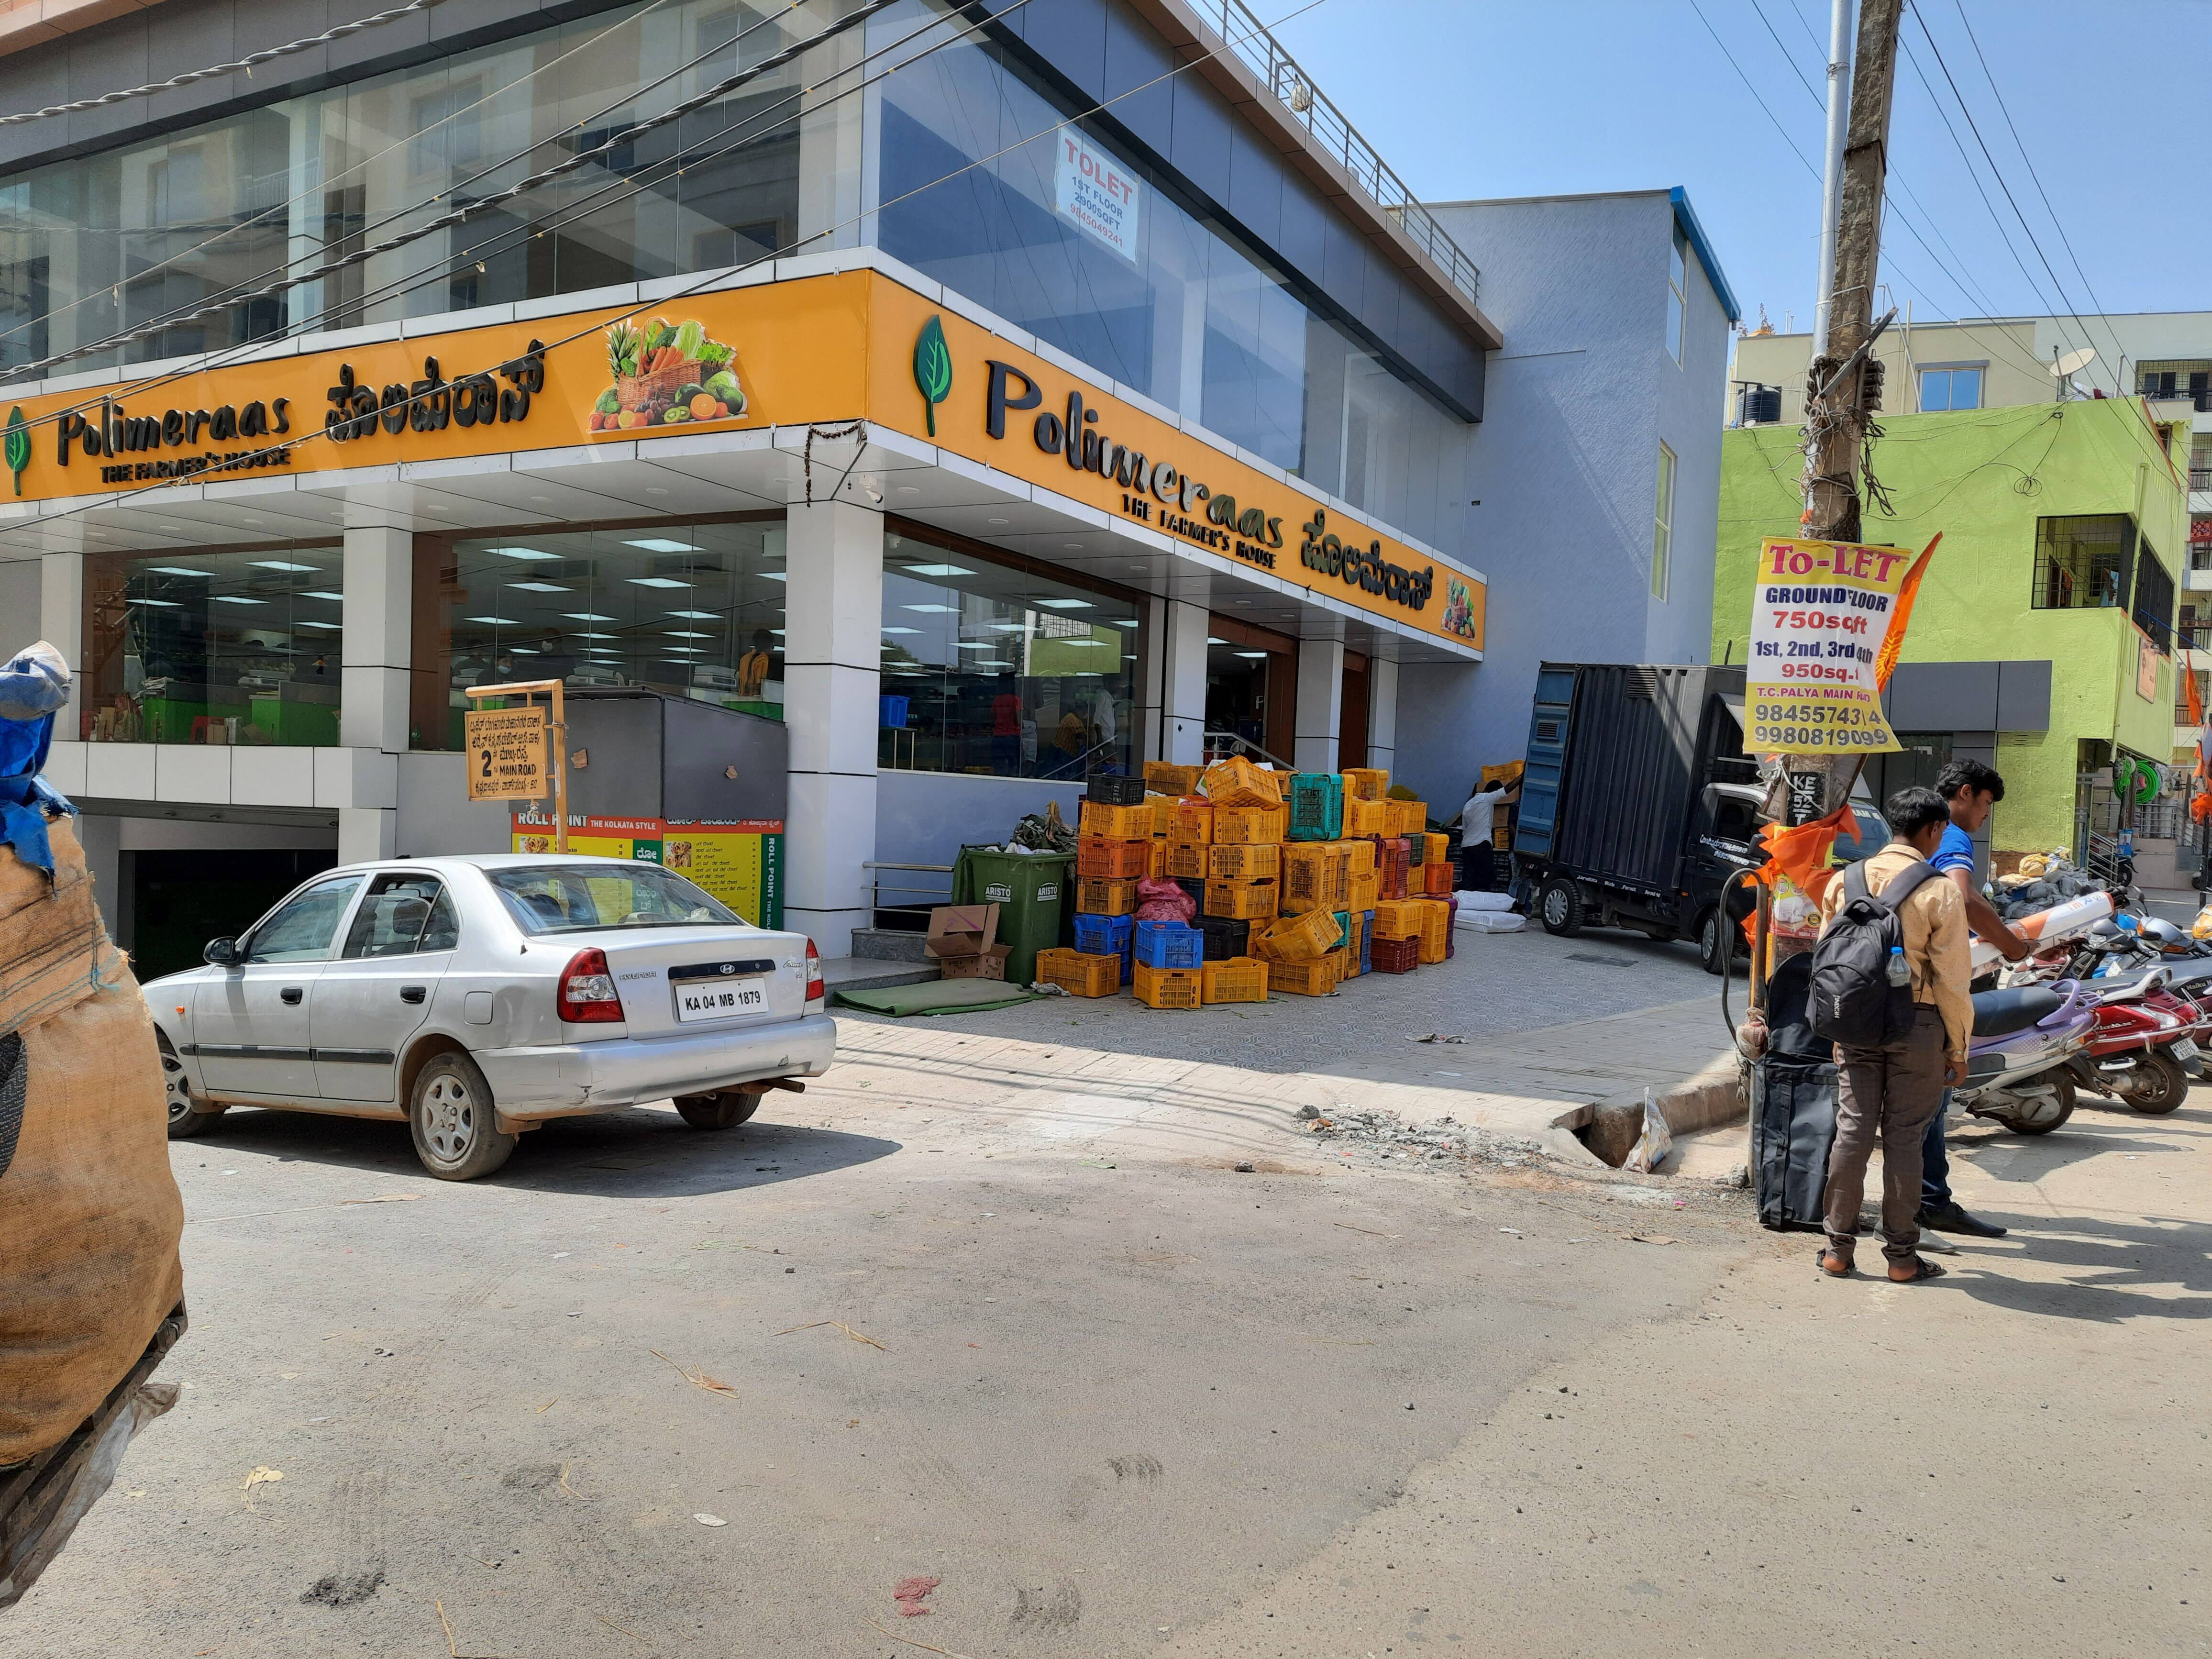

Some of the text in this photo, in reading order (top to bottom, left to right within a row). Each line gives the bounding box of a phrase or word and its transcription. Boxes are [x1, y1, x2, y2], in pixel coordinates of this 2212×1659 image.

[1065, 137, 1132, 205] TOLET
[1072, 177, 1123, 219] 1ST FLOOR
[1075, 192, 1120, 230] 2900SQFT
[58, 394, 290, 466] Polimeraas
[100, 448, 290, 483] THE FARMER'S HOUSE
[985, 360, 1283, 548] Polimeraas
[1122, 494, 1276, 569] THE FARMER'S HOUSE
[1770, 544, 1901, 583] To-LET
[1766, 587, 1888, 612] GROUND FLOOR
[1772, 610, 1868, 634] 750sqft
[1756, 641, 1873, 664] 1st, 2nd, 3rd 4th
[1757, 686, 1819, 699] T.C.PALYA
[1823, 688, 1854, 699] MAIN
[1755, 726, 1889, 746] 9980819099
[482, 750, 491, 777] 2
[500, 764, 517, 776] MAIN
[519, 763, 536, 775] ROAD
[1794, 775, 1816, 790] KE
[1793, 795, 1813, 808] 52
[518, 813, 549, 826] ROLL
[604, 820, 633, 829] KOLKATA
[635, 822, 656, 830] STYLE
[985, 886, 1011, 897] ARISTO
[1038, 885, 1058, 896] ARISTO
[685, 990, 761, 1011] KA 04 MB 1879
[1191, 986, 1197, 1005] 06
